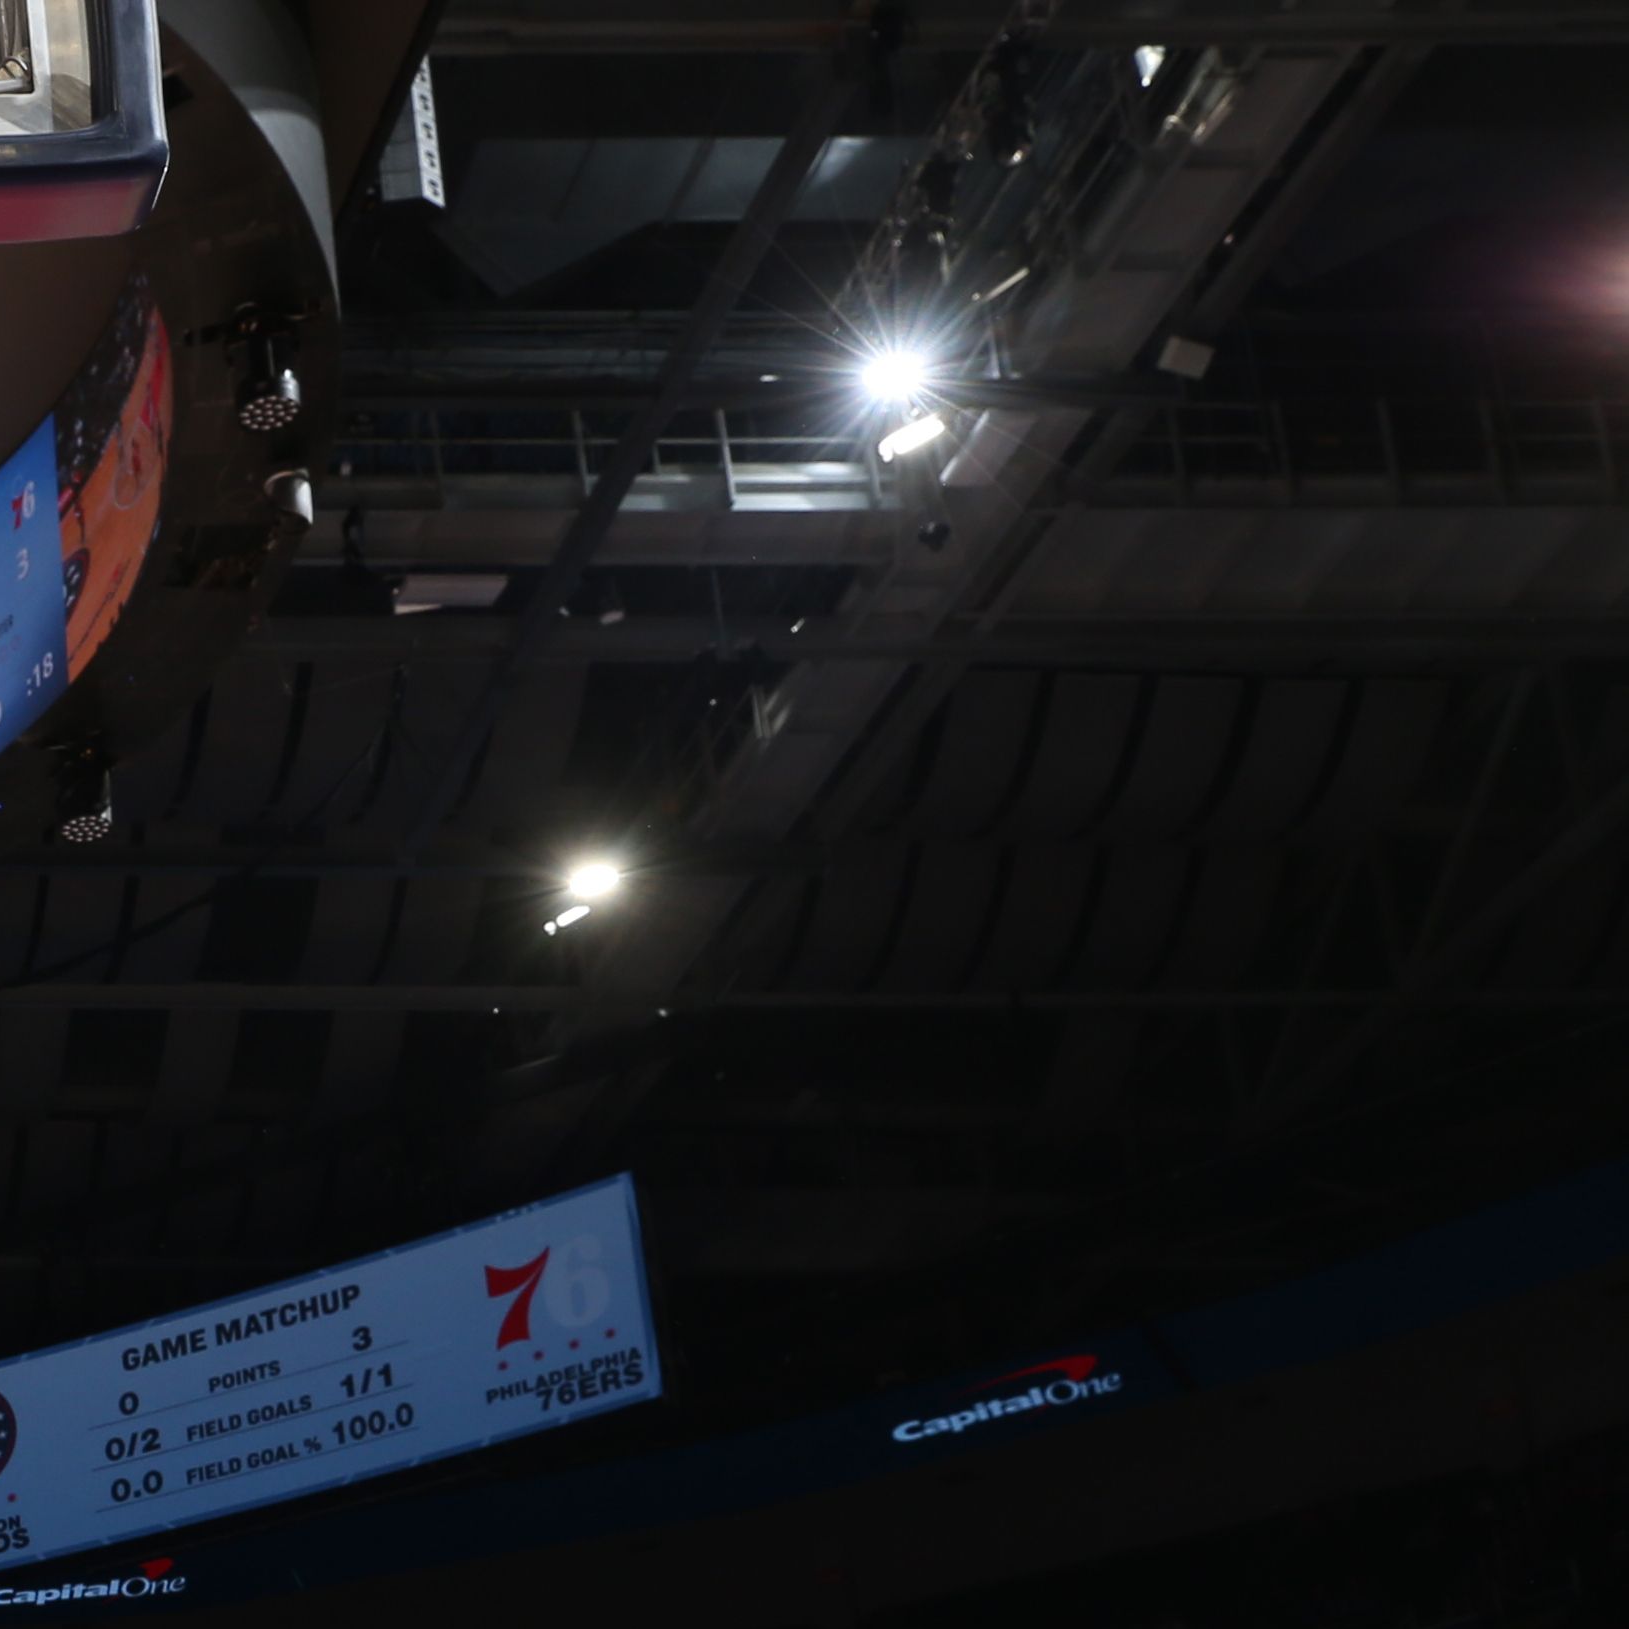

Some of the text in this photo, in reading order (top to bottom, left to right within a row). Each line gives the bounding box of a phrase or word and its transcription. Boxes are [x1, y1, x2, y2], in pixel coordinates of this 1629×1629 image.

[16, 548, 29, 581] 3
[484, 1236, 610, 1350] 76
[121, 1284, 360, 1371] GAME MATCHUP
[351, 1326, 373, 1351] 3
[208, 1360, 282, 1393] POINTS
[339, 1363, 393, 1398] 1/1
[485, 1347, 642, 1405] PHILADELPHIA
[535, 1362, 643, 1411] 76ERS
[118, 1391, 140, 1416] 0
[186, 1395, 313, 1442] FIELD GOALS
[331, 1402, 415, 1445] 100.0
[104, 1428, 162, 1461] 0/2
[186, 1436, 322, 1485] FIELD GOAL %
[110, 1470, 164, 1502] 0.0
